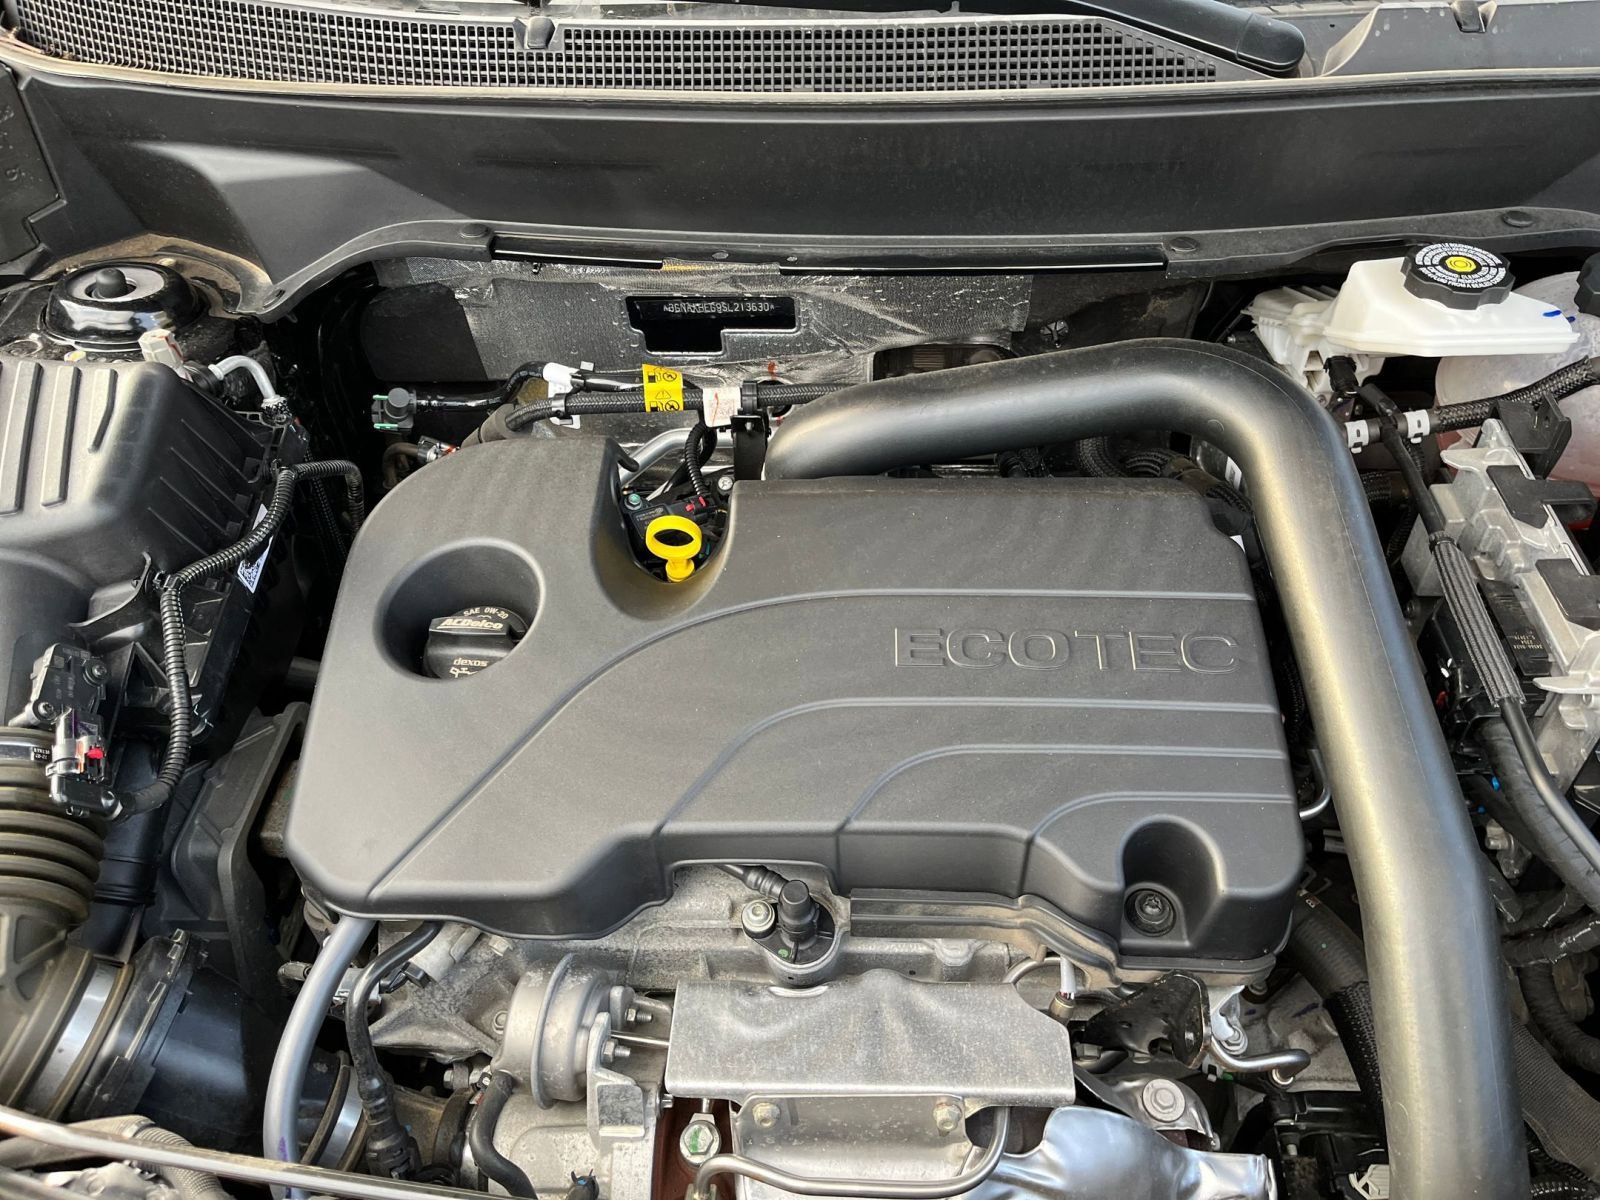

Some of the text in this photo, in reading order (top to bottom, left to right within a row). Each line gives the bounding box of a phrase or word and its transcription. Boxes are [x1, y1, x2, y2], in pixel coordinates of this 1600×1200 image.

[463, 607, 509, 619] SAE 0W-20
[440, 618, 504, 630] ACDelco
[894, 625, 1240, 676] ECOTEC
[453, 657, 488, 667] dexos
